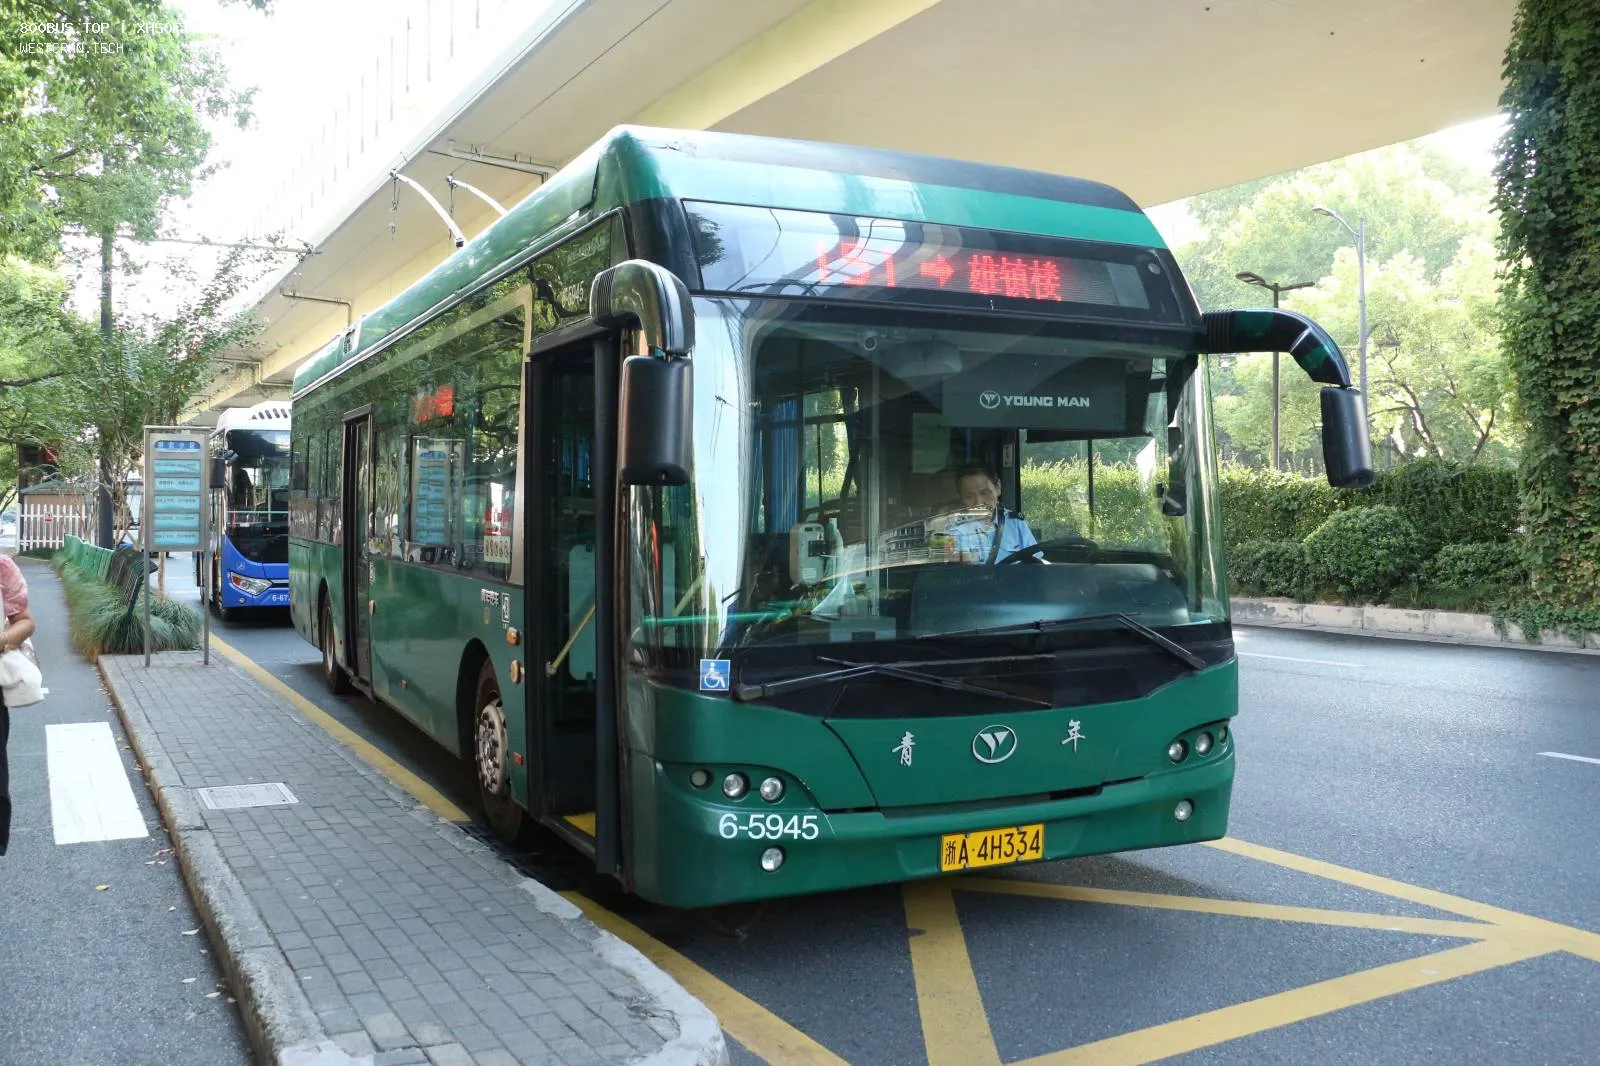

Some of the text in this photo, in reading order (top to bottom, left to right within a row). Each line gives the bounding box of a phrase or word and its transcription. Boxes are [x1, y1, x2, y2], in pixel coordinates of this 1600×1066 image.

[1003, 395, 1090, 408] YOUNG MAN
[272, 594, 291, 602] 6-67
[892, 719, 1086, 767] 青 年
[718, 813, 820, 840] 6-5945
